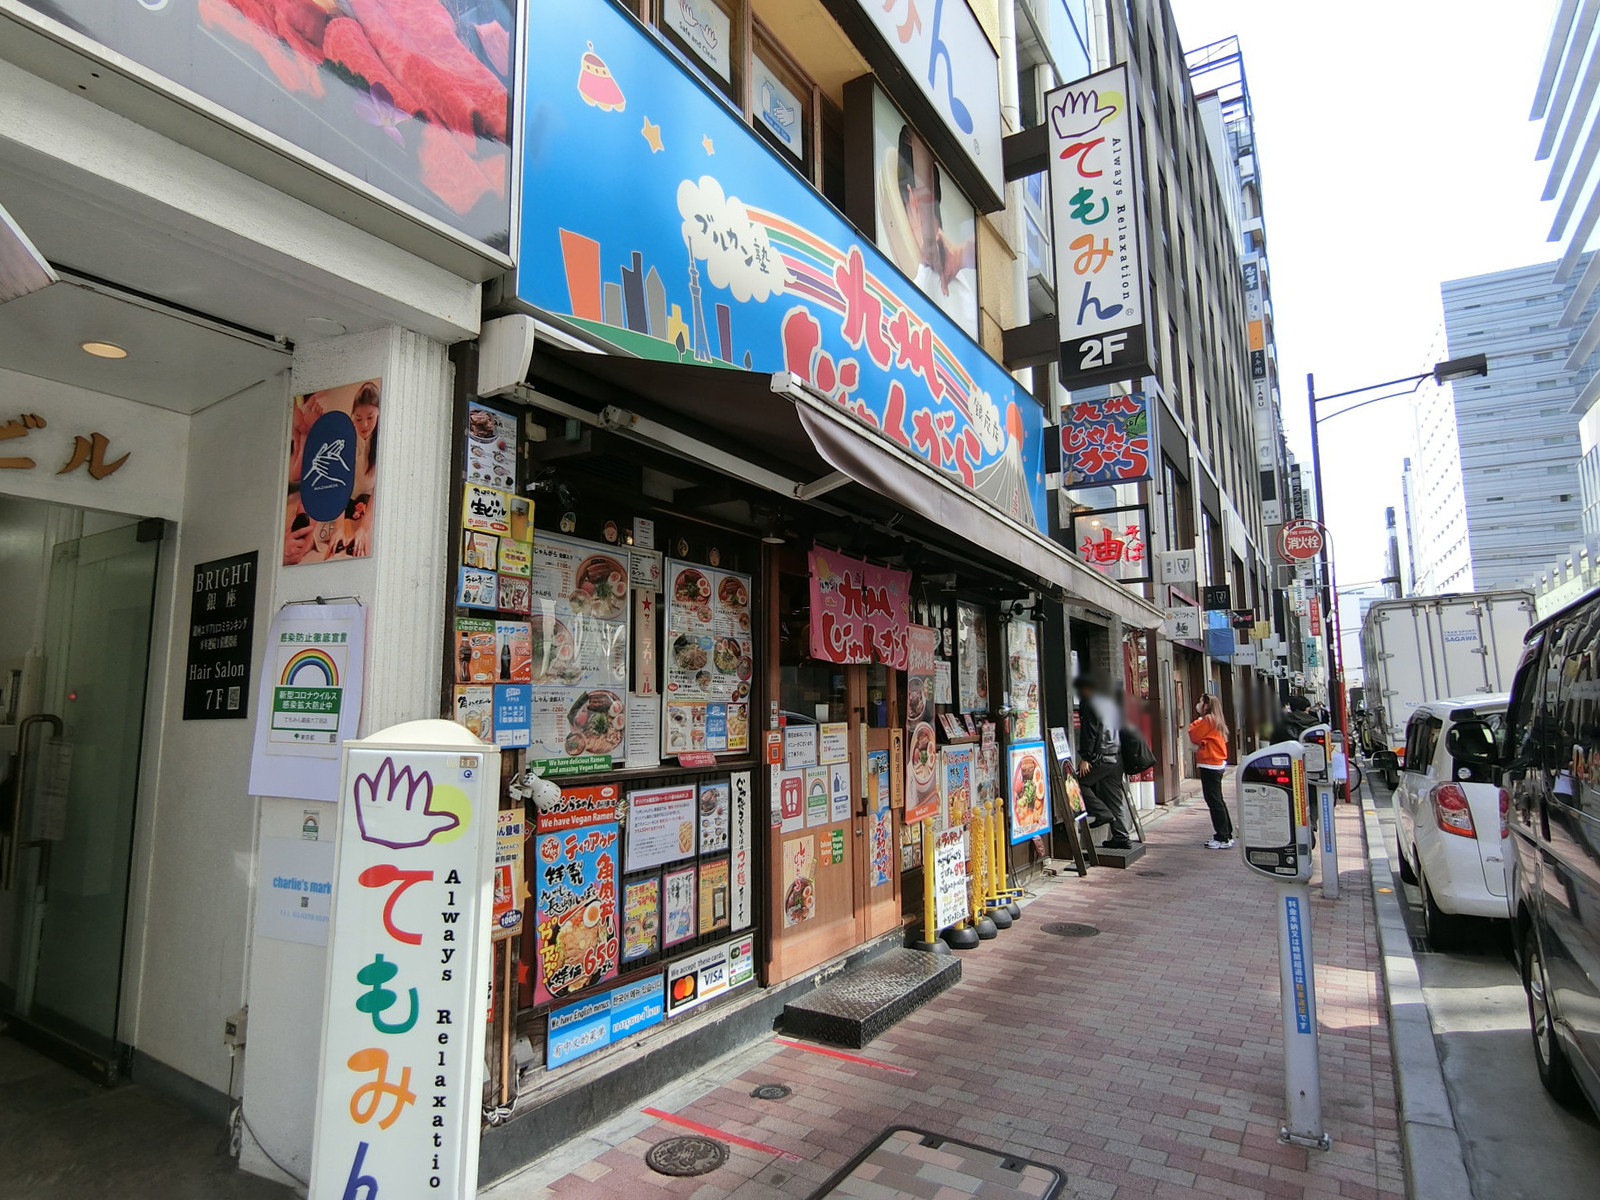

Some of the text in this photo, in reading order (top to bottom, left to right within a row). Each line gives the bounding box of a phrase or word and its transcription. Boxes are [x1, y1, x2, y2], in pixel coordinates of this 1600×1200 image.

[679, 21, 718, 63] Safe and Clean
[1112, 137, 1130, 300] Always Relaxation
[1059, 136, 1124, 326] てもみん
[694, 212, 772, 275] ブルカン塾
[832, 244, 947, 404] 九州
[1078, 332, 1128, 371] 2F
[1257, 385, 1265, 407] TARU
[1073, 394, 1140, 423] 九州
[1061, 422, 1126, 455] じゃん
[1073, 437, 1149, 480] がら
[471, 497, 507, 518] 生ビール
[319, 521, 335, 540] 6F
[1078, 526, 1125, 564] 油
[1124, 524, 1146, 562] そば
[1287, 535, 1320, 550] 消火栓
[195, 562, 252, 593] BRIGHT
[465, 574, 493, 585] ラムネハイ
[206, 588, 237, 612] 銀座
[280, 632, 348, 643] 感染防止徹底宣言
[497, 625, 529, 634] コカコーラ
[1175, 621, 1189, 634] 麺
[1444, 635, 1478, 643] SAGAWA
[188, 659, 245, 681] Hair Salon
[205, 688, 225, 711] 7F
[279, 690, 338, 701] 新型コロナウイルス
[281, 700, 334, 712] 感染拡大防止中
[549, 759, 556, 767] We
[556, 758, 569, 766] have
[569, 758, 589, 766] delicious
[559, 765, 579, 774] amazing
[579, 764, 594, 772] Vegan
[594, 763, 611, 771] Ramen.
[541, 811, 614, 829] We have Vegan Ramen
[272, 876, 309, 892] charlie's
[584, 937, 619, 977] 650
[671, 950, 725, 978] We accept these cards.
[703, 968, 724, 986] VISA
[612, 991, 629, 1007] 한국어
[641, 978, 664, 995] 있습니다
[552, 1000, 611, 1028] We have English menus.
[429, 869, 462, 1189] Always Relaxatio
